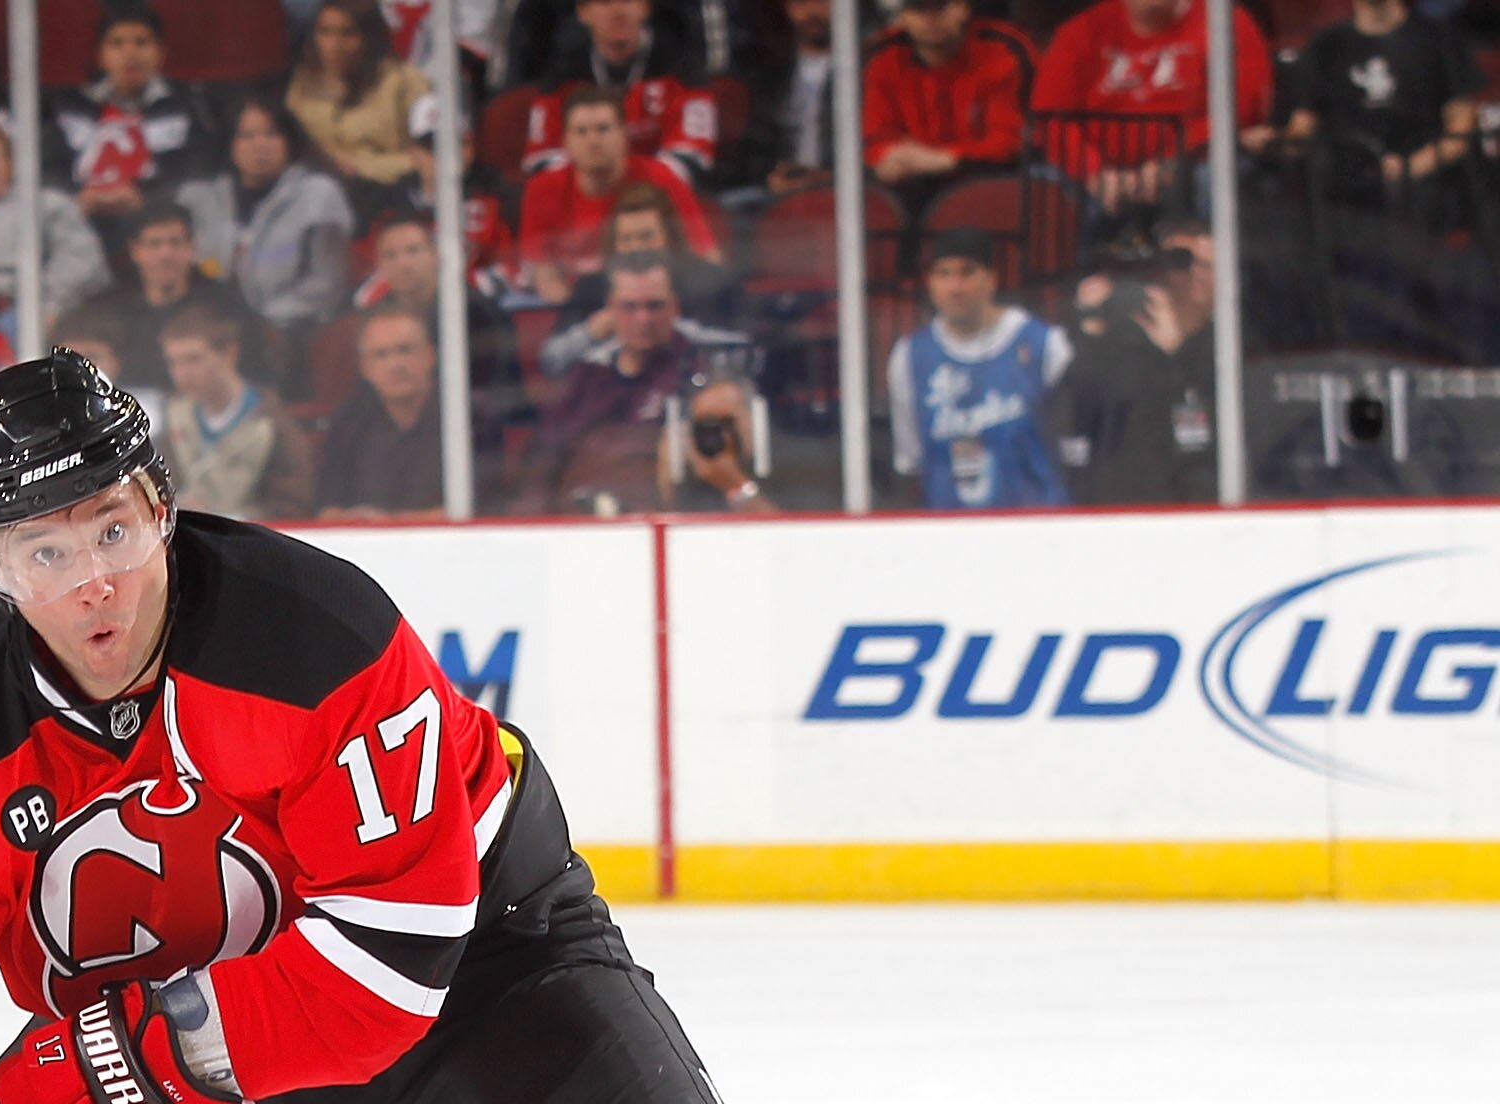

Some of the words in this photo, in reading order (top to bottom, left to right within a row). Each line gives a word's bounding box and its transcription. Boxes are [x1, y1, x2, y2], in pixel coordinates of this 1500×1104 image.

[800, 623, 1183, 720] BUD
[1264, 619, 1500, 716] LIG
[336, 686, 442, 844] 17
[8, 795, 50, 844] PB
[35, 1035, 66, 1065] 17
